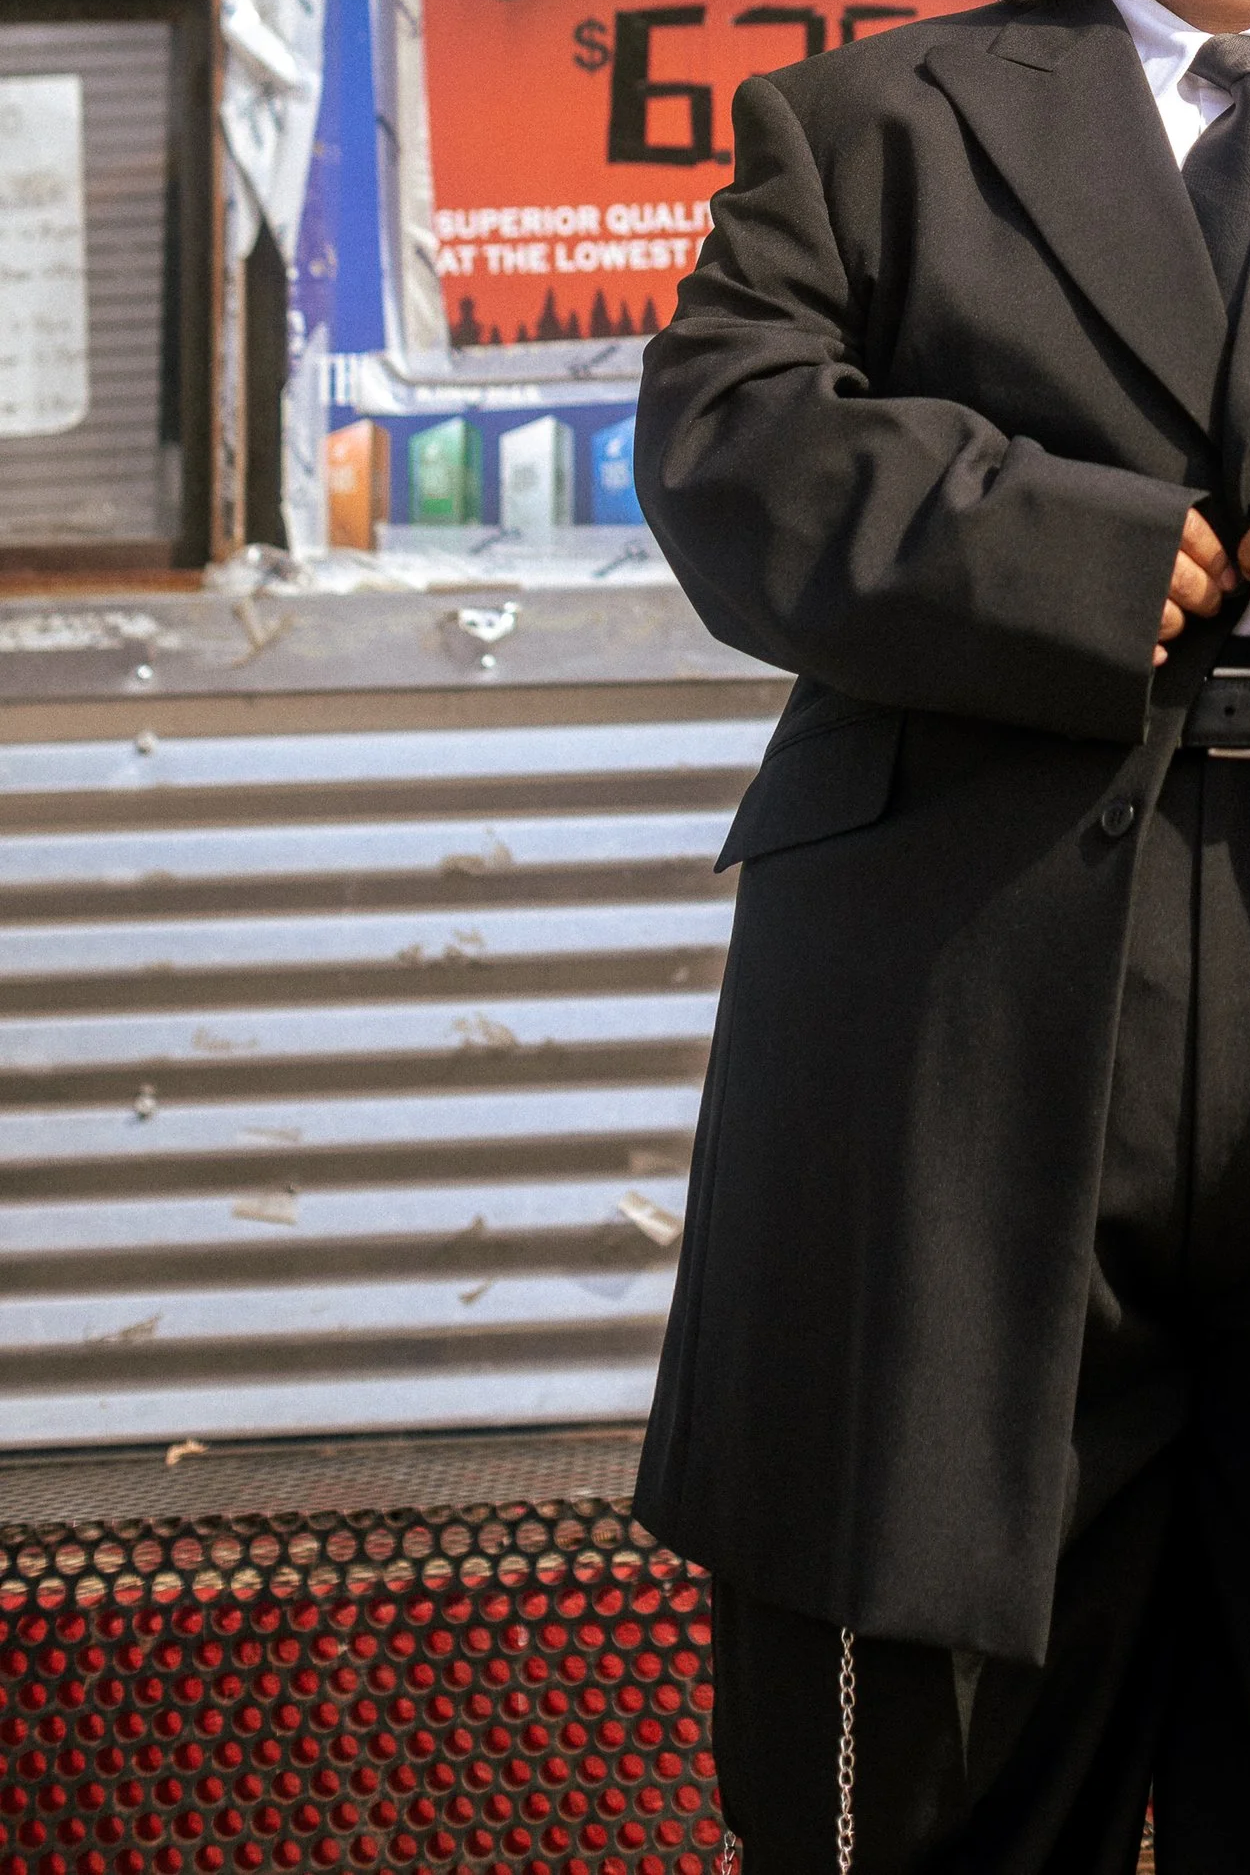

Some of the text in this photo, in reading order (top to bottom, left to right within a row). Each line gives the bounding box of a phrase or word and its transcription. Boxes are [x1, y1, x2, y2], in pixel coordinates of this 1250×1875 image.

[435, 205, 601, 241] SUPERIOR
[435, 243, 478, 276] AT
[483, 241, 551, 274] THE
[555, 237, 691, 272] LOWEST
